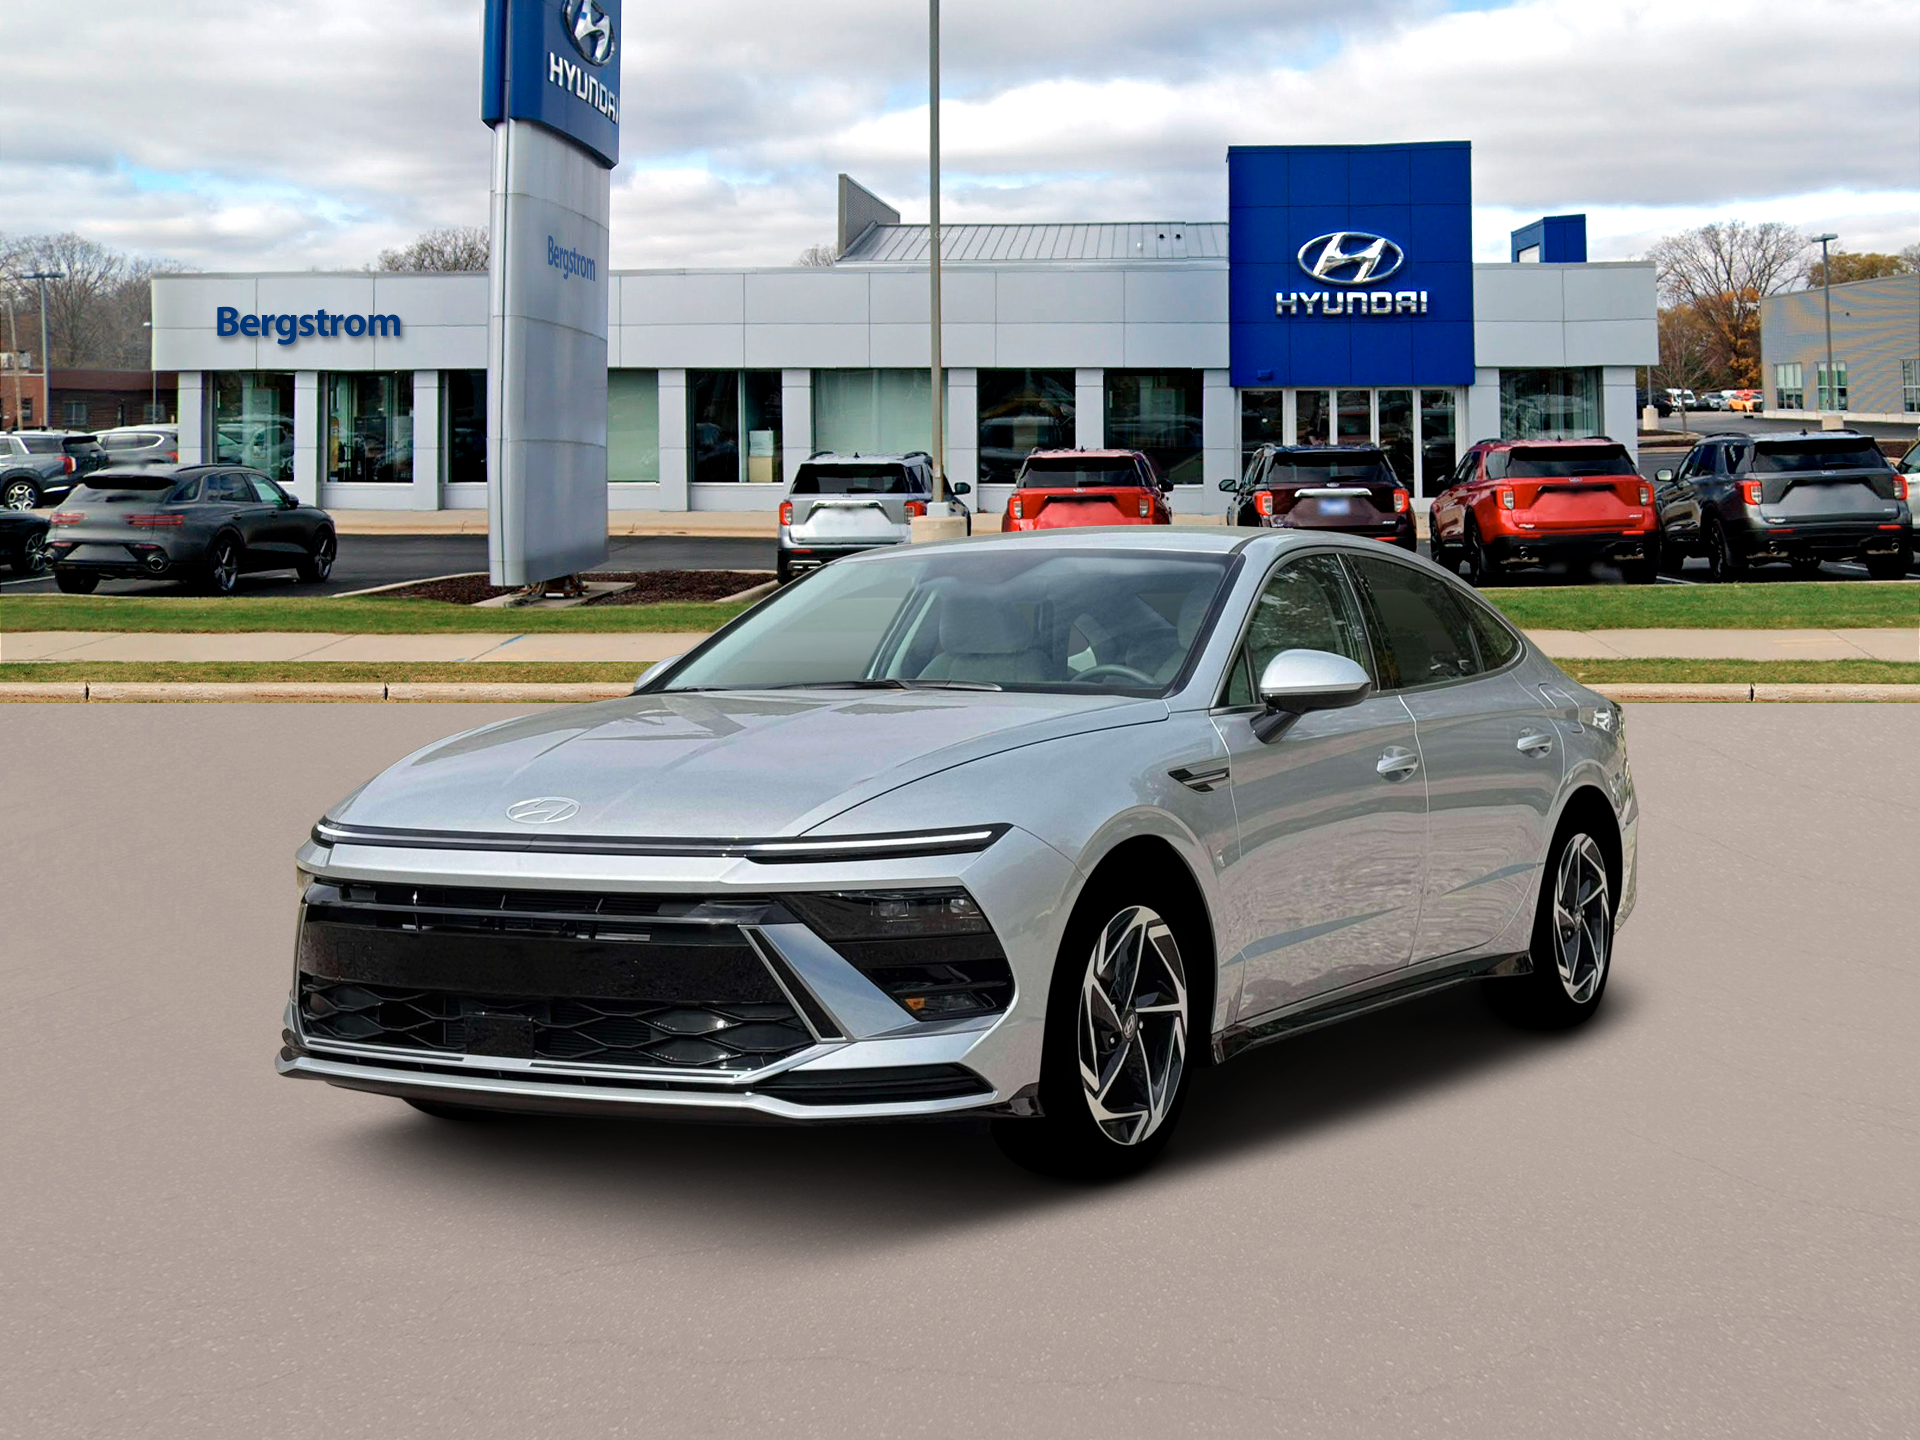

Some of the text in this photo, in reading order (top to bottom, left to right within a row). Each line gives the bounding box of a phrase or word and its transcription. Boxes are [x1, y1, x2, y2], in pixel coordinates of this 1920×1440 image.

[549, 52, 619, 124] HYUNDAI
[547, 235, 596, 282] Bergstrom
[1275, 290, 1428, 315] HYUNDAI
[216, 306, 402, 346] Bergstrom
